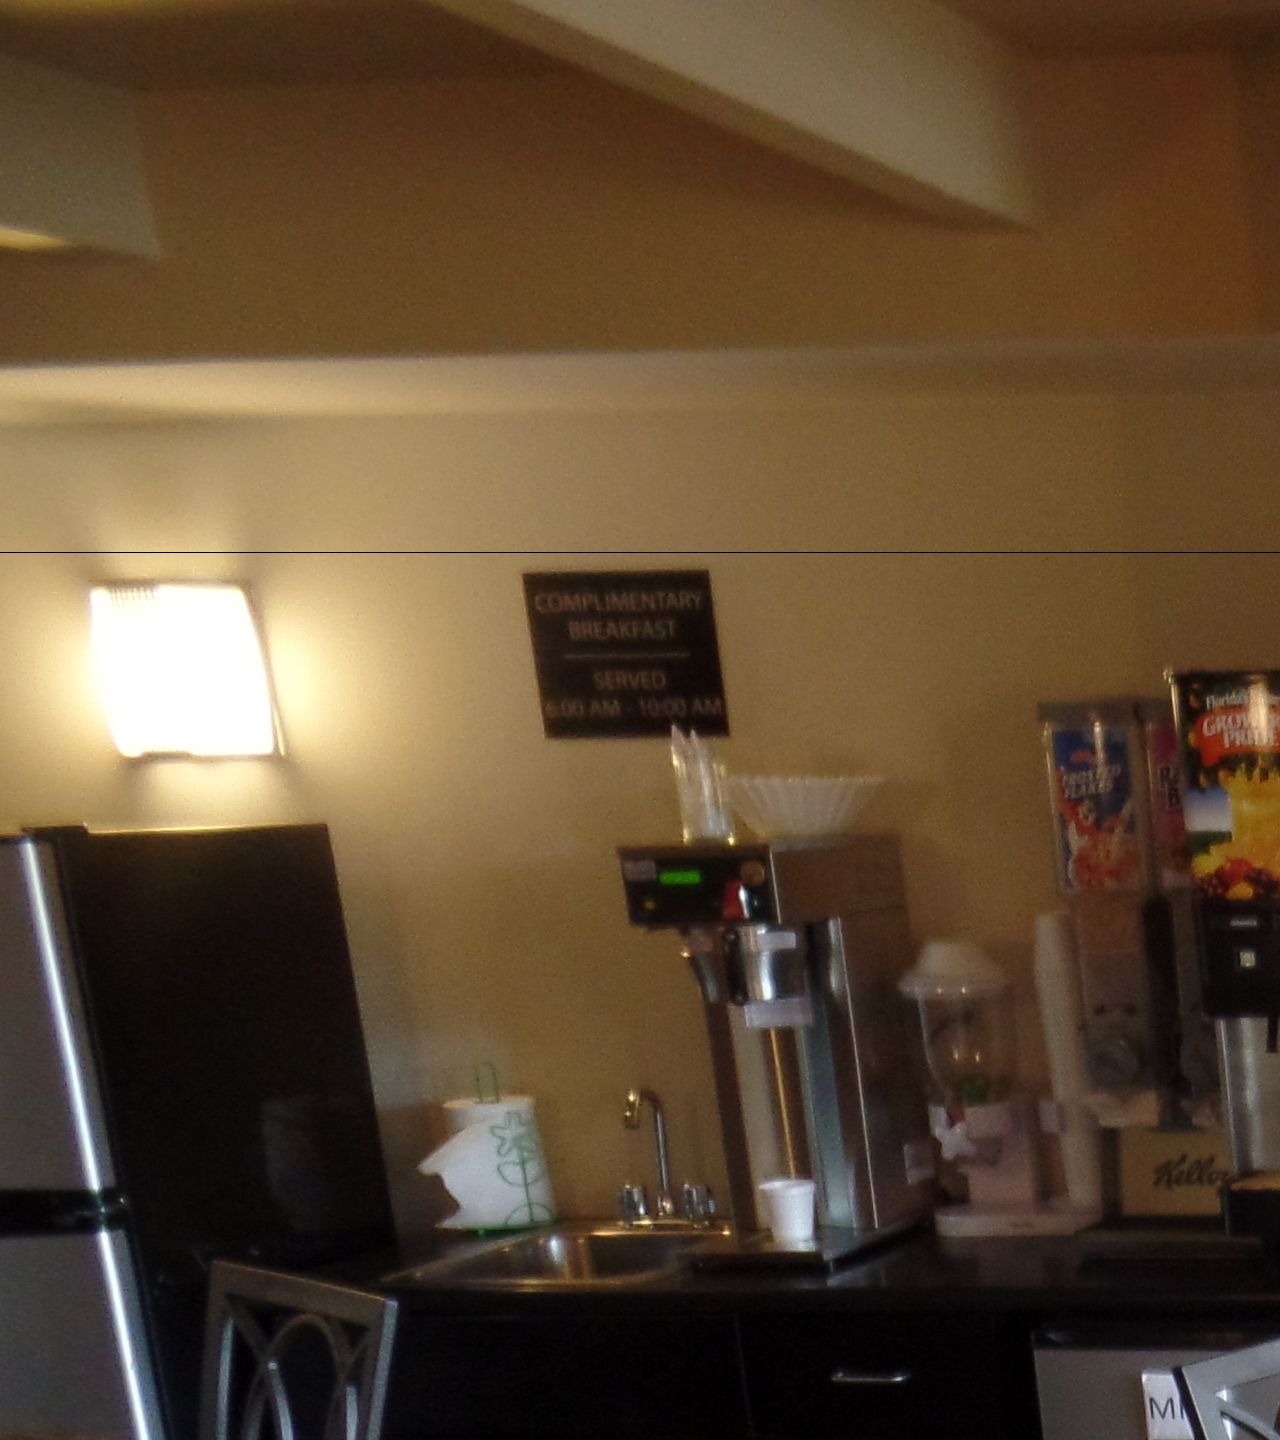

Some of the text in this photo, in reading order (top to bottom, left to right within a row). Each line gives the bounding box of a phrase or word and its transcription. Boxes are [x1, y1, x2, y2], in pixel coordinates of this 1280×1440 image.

[535, 591, 703, 613] COMPLIMENTARY
[568, 620, 676, 640] BREAKFAST
[593, 670, 667, 690] SERVED
[590, 699, 621, 717] AM
[692, 699, 723, 716] AM
